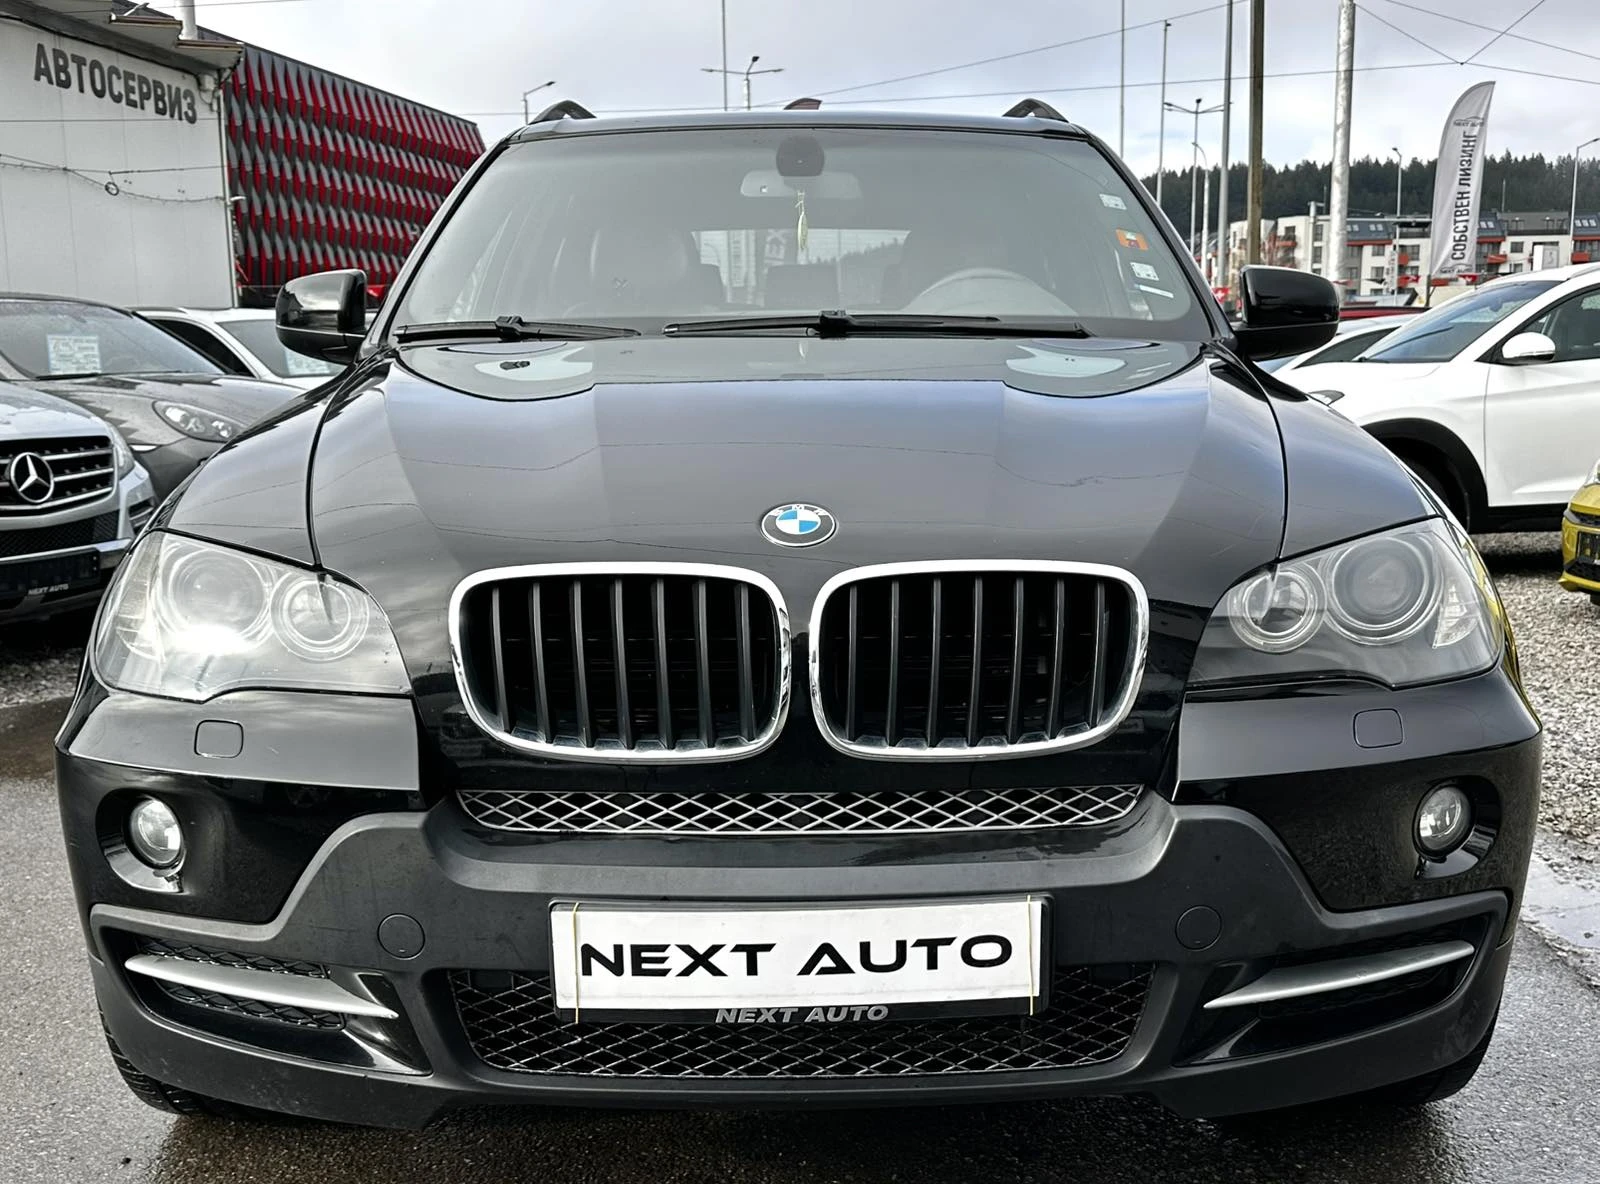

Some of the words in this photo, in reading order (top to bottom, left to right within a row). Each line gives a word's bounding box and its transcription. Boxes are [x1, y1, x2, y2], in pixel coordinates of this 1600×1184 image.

[34, 43, 197, 125] АВТОСЕРВИЗ
[1458, 131, 1478, 187] ЛИЗИНГ
[1451, 191, 1470, 260] СОБСТВЕН
[581, 943, 777, 977] NEXT
[796, 934, 1013, 976] AUTO
[715, 1007, 799, 1023] NEXT
[804, 1005, 889, 1023] AUTO
